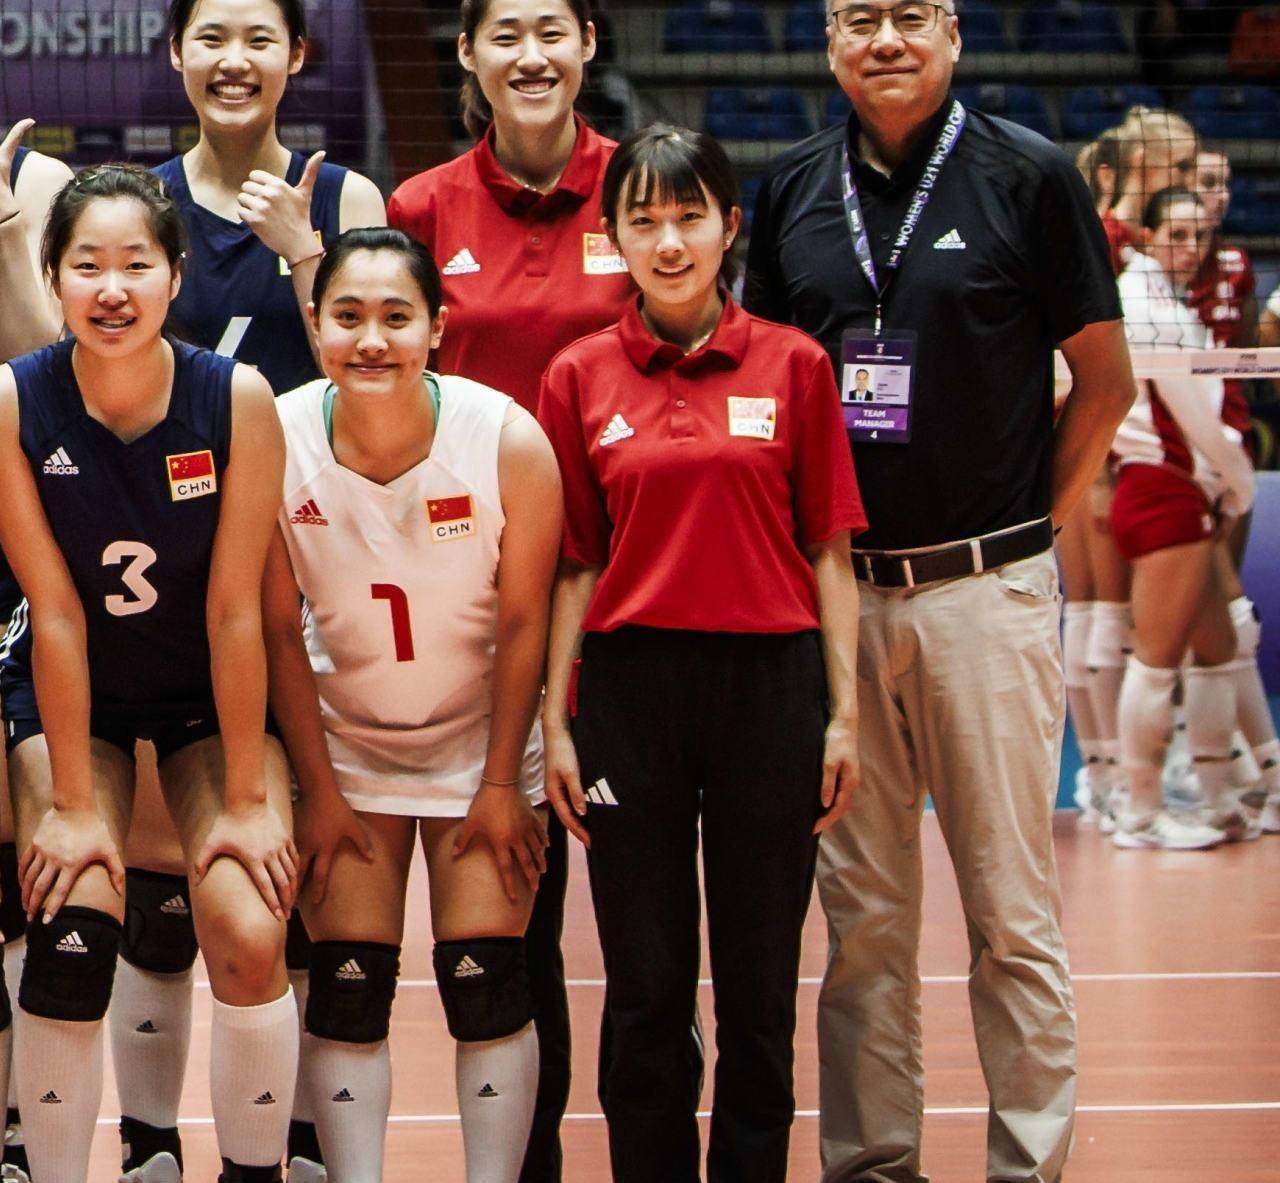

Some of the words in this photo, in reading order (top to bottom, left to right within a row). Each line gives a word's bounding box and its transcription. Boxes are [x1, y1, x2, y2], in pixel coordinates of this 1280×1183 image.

[895, 190, 929, 247] WOMEN'S
[920, 163, 940, 189] U21
[443, 262, 481, 275] adidas
[863, 409, 886, 418] TEAM
[854, 420, 895, 428] MANAGER
[43, 464, 79, 475] adidas
[177, 480, 211, 496] CHN
[290, 515, 328, 527] adidas
[436, 521, 470, 537] CHN
[102, 540, 159, 617] 3
[371, 583, 415, 663] 1
[56, 943, 88, 953] adidas
[454, 965, 485, 978] adidas
